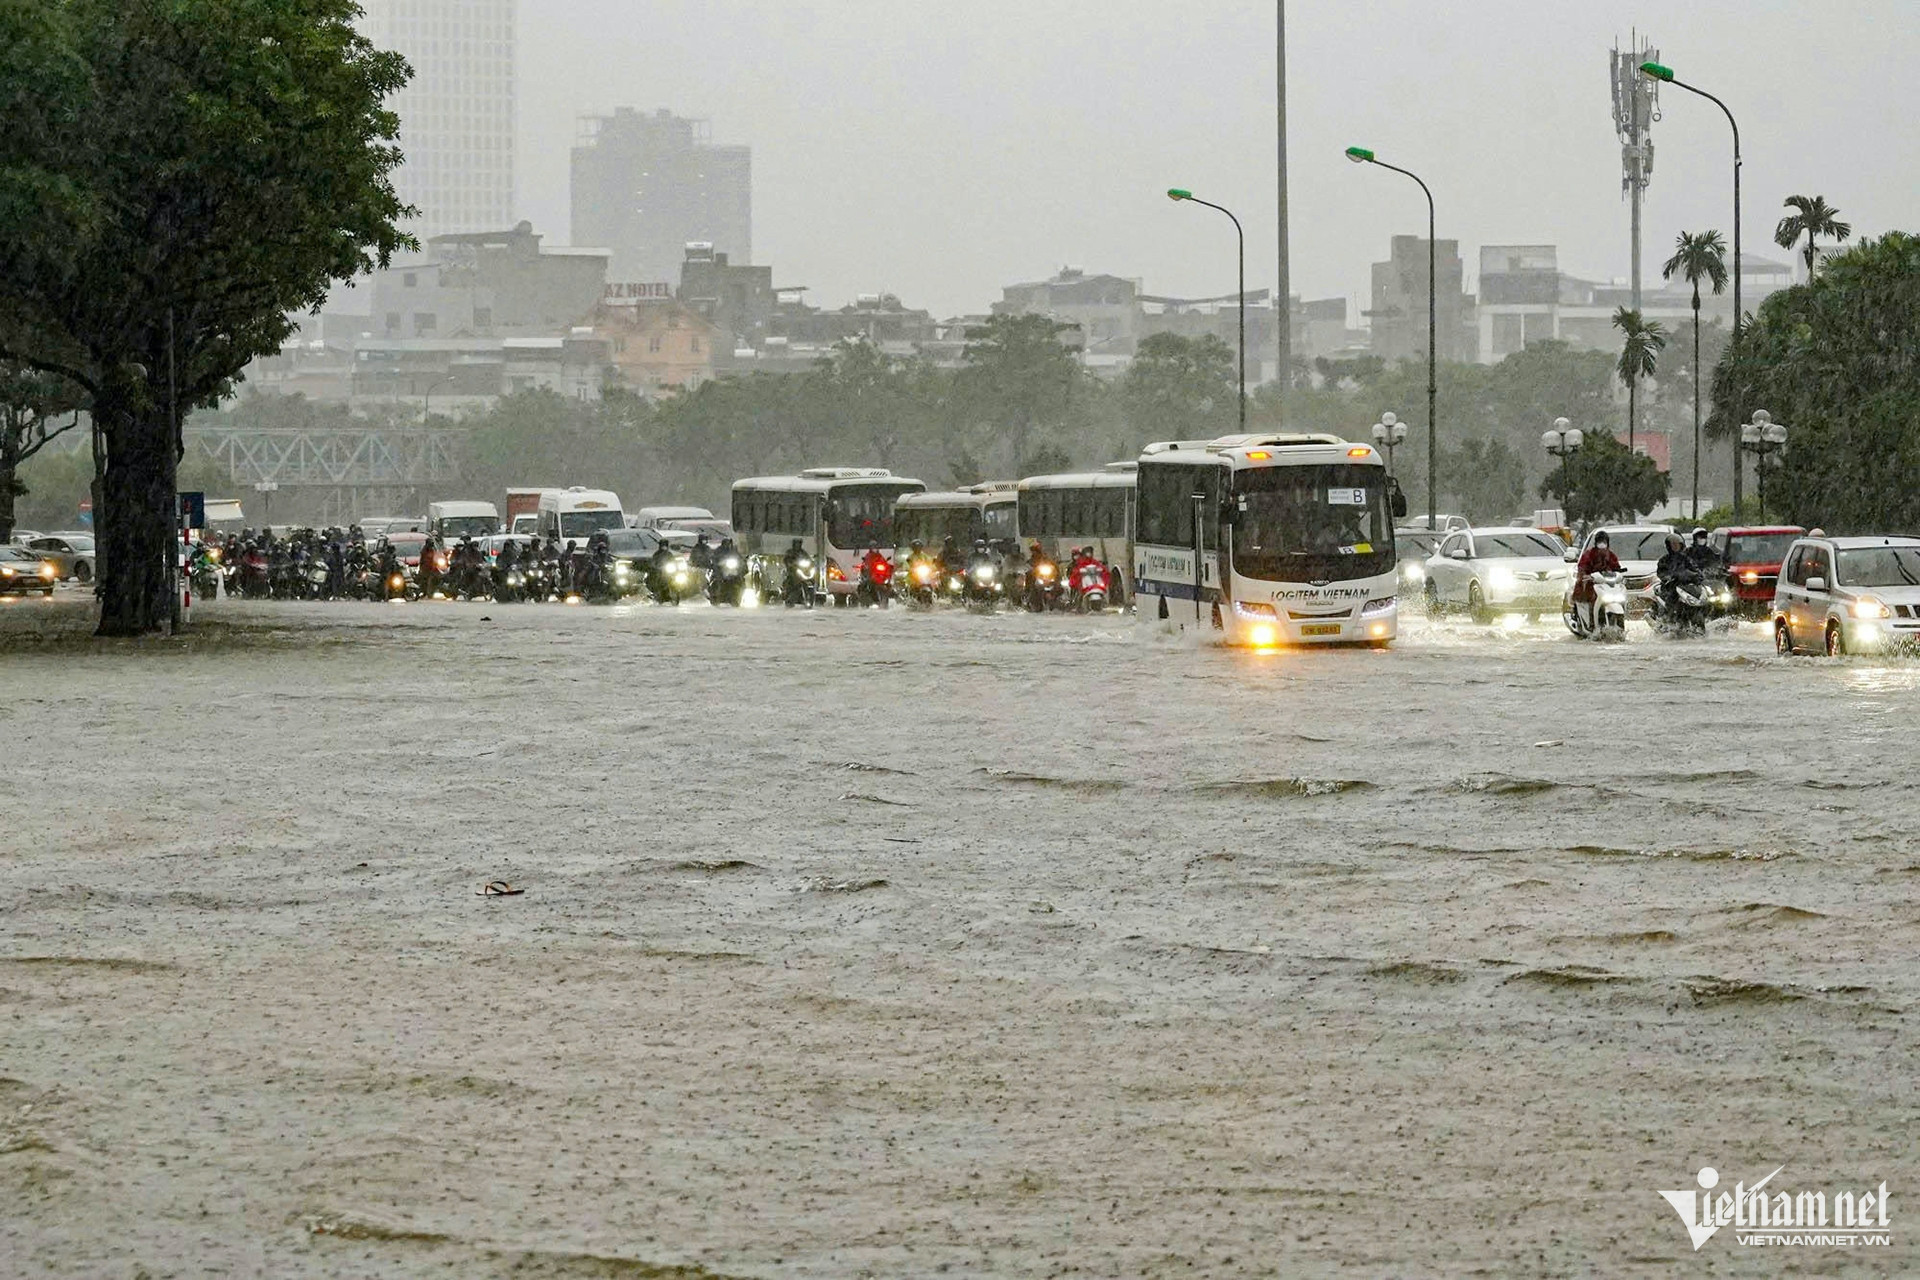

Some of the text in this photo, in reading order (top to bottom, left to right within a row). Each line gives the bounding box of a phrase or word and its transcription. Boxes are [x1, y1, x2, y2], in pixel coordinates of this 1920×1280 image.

[604, 282, 669, 298] AZ HOTEL
[1353, 489, 1363, 503] B
[1271, 588, 1370, 601] LOGITEM VIETNAM
